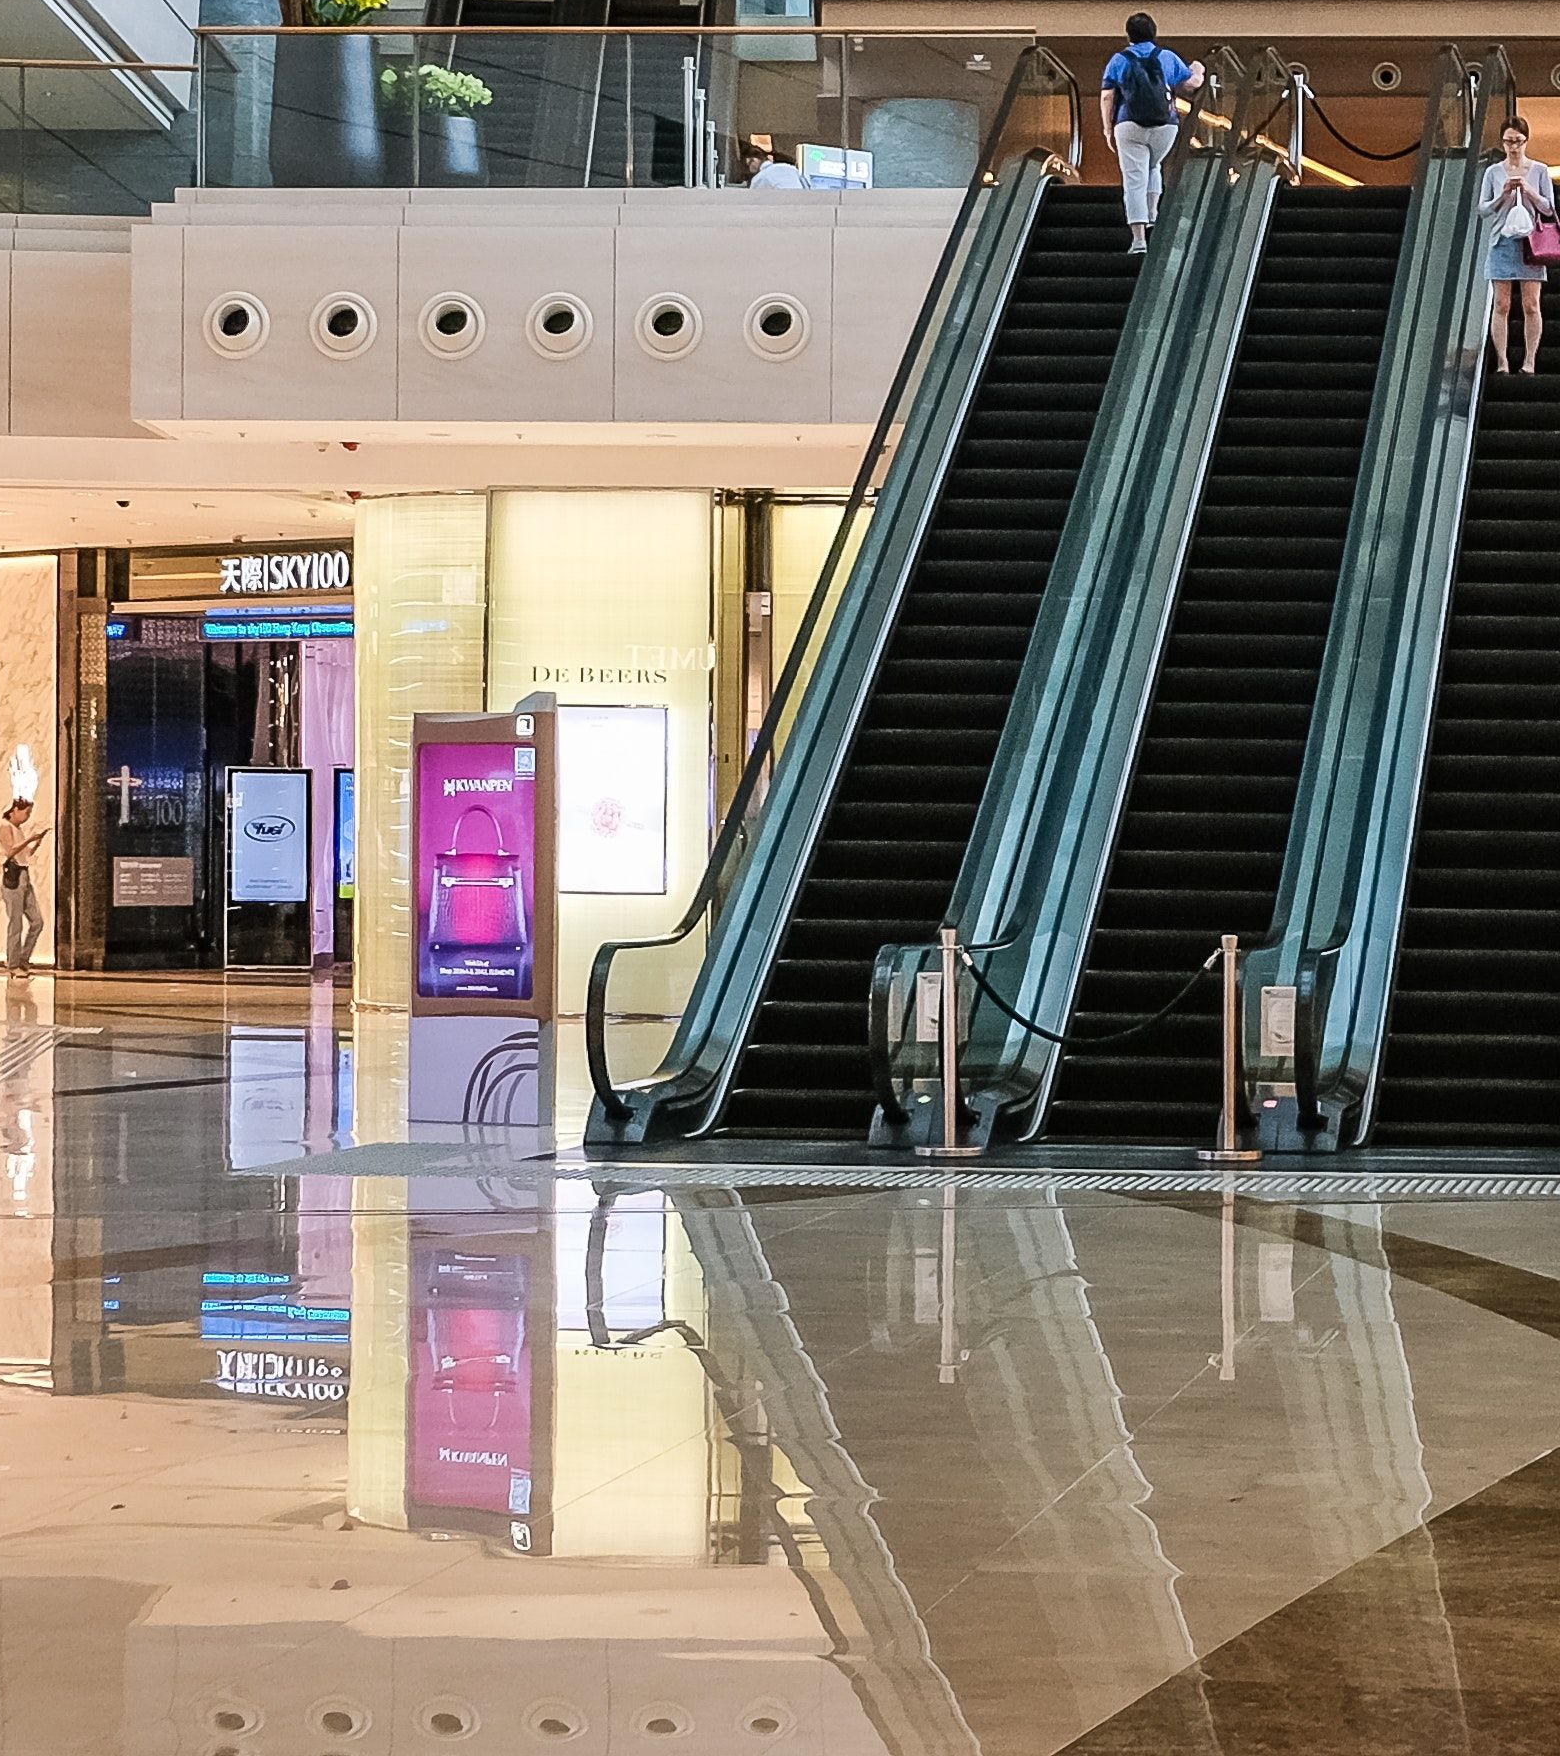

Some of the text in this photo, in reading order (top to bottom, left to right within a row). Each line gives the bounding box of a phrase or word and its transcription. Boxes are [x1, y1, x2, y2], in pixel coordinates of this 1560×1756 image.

[219, 557, 264, 593] 天際
[269, 550, 350, 591] SKY100
[531, 665, 668, 684] DE BEERS
[455, 778, 514, 793] KWANPEN
